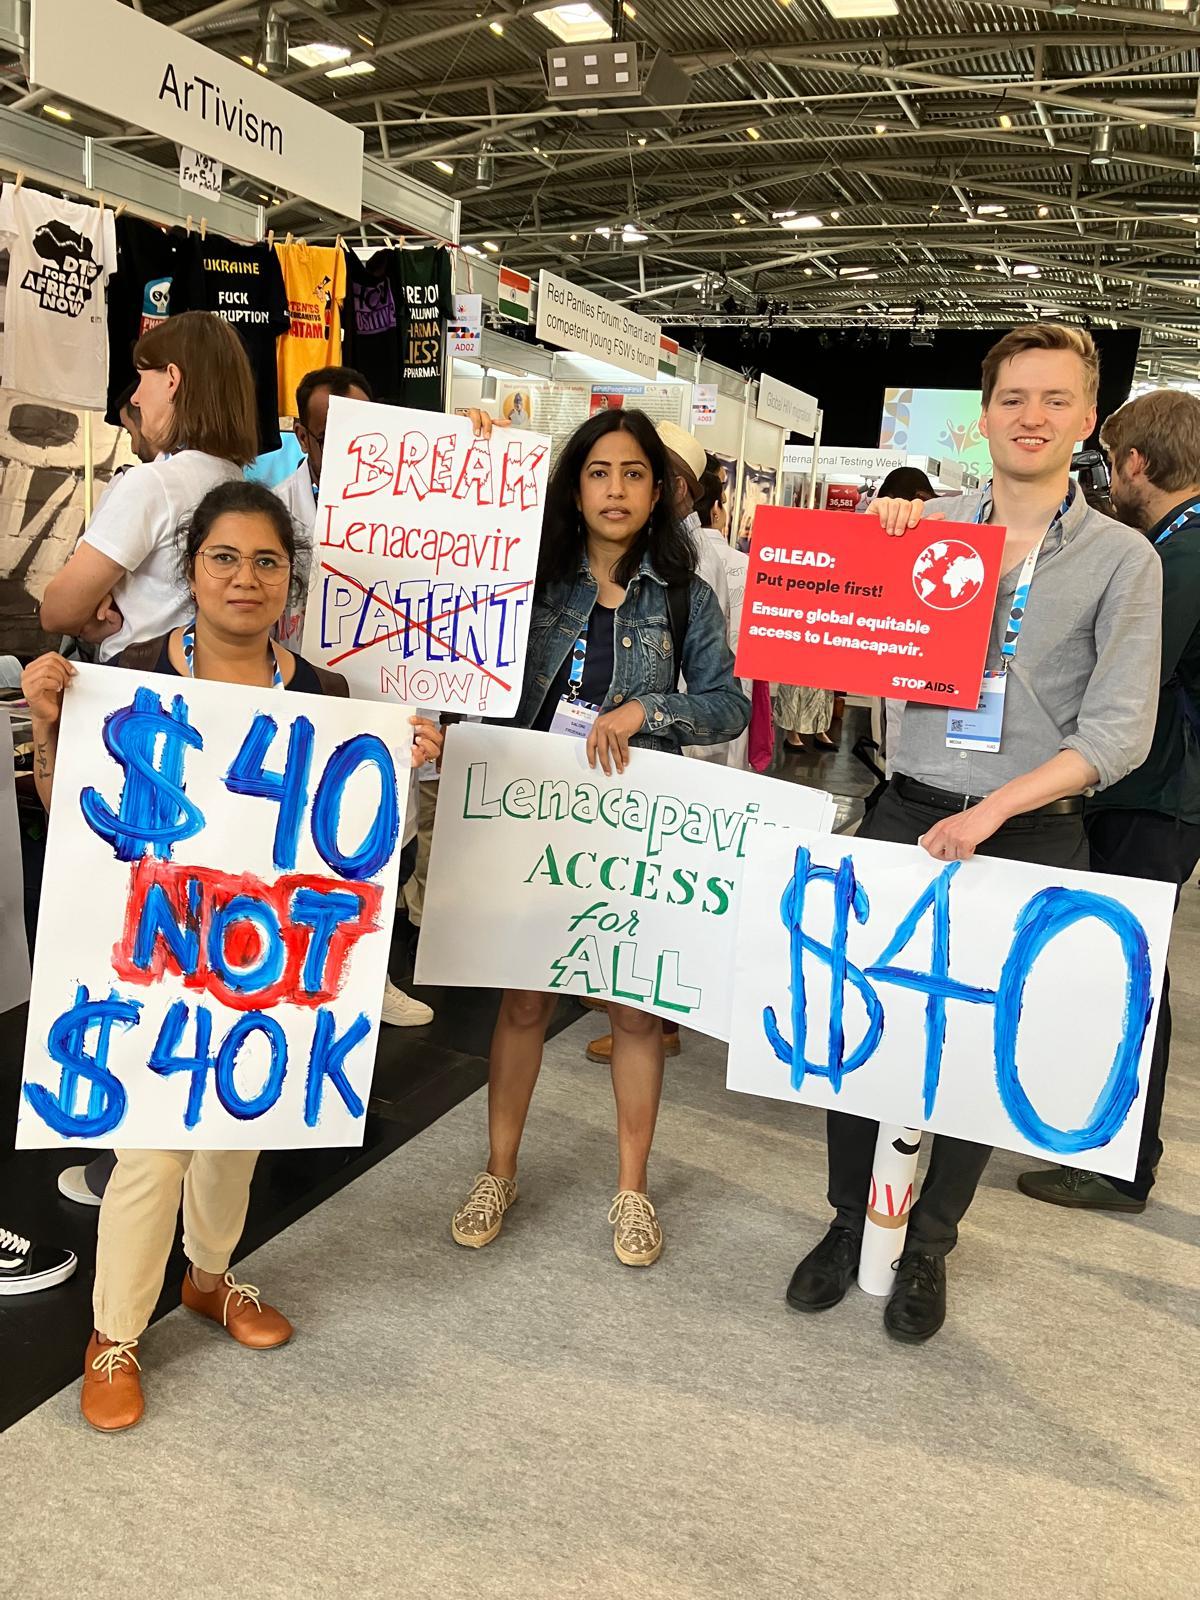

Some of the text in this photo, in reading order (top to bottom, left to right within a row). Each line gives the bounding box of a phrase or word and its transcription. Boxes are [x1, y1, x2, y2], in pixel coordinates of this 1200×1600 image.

[159, 63, 283, 155] ArTivism
[195, 153, 217, 173] NOT
[45, 267, 90, 290] FOR ALL
[203, 258, 260, 274] UKRAINE
[24, 272, 85, 303] AFRICA
[218, 291, 249, 305] FUCK
[403, 284, 422, 305] RE
[42, 293, 82, 316] NOW
[548, 282, 656, 346] Red Panties Forum: Smart and
[287, 319, 324, 340] ATAM
[546, 314, 655, 369] competent young FSW's forum
[455, 343, 475, 351] AD02
[342, 430, 548, 512] BREAK
[783, 455, 904, 468] nternaonal Testing Week
[829, 498, 853, 507] 36,581
[320, 504, 521, 575] Lenacapavir
[759, 546, 836, 569] GILEAD:
[756, 571, 784, 588] Put
[786, 578, 840, 595] people
[844, 582, 883, 598] first!
[321, 573, 529, 668] PATENT
[752, 601, 931, 635] Ensure global equitable
[748, 625, 924, 658] access to Lenacapavir.
[381, 664, 491, 711] NOW!
[463, 762, 776, 858] Lenacapavi
[523, 843, 735, 915] ACCESS
[124, 868, 374, 1003] NOT
[567, 901, 641, 937] for
[549, 934, 702, 1014] ALL
[763, 844, 1154, 1155] $40
